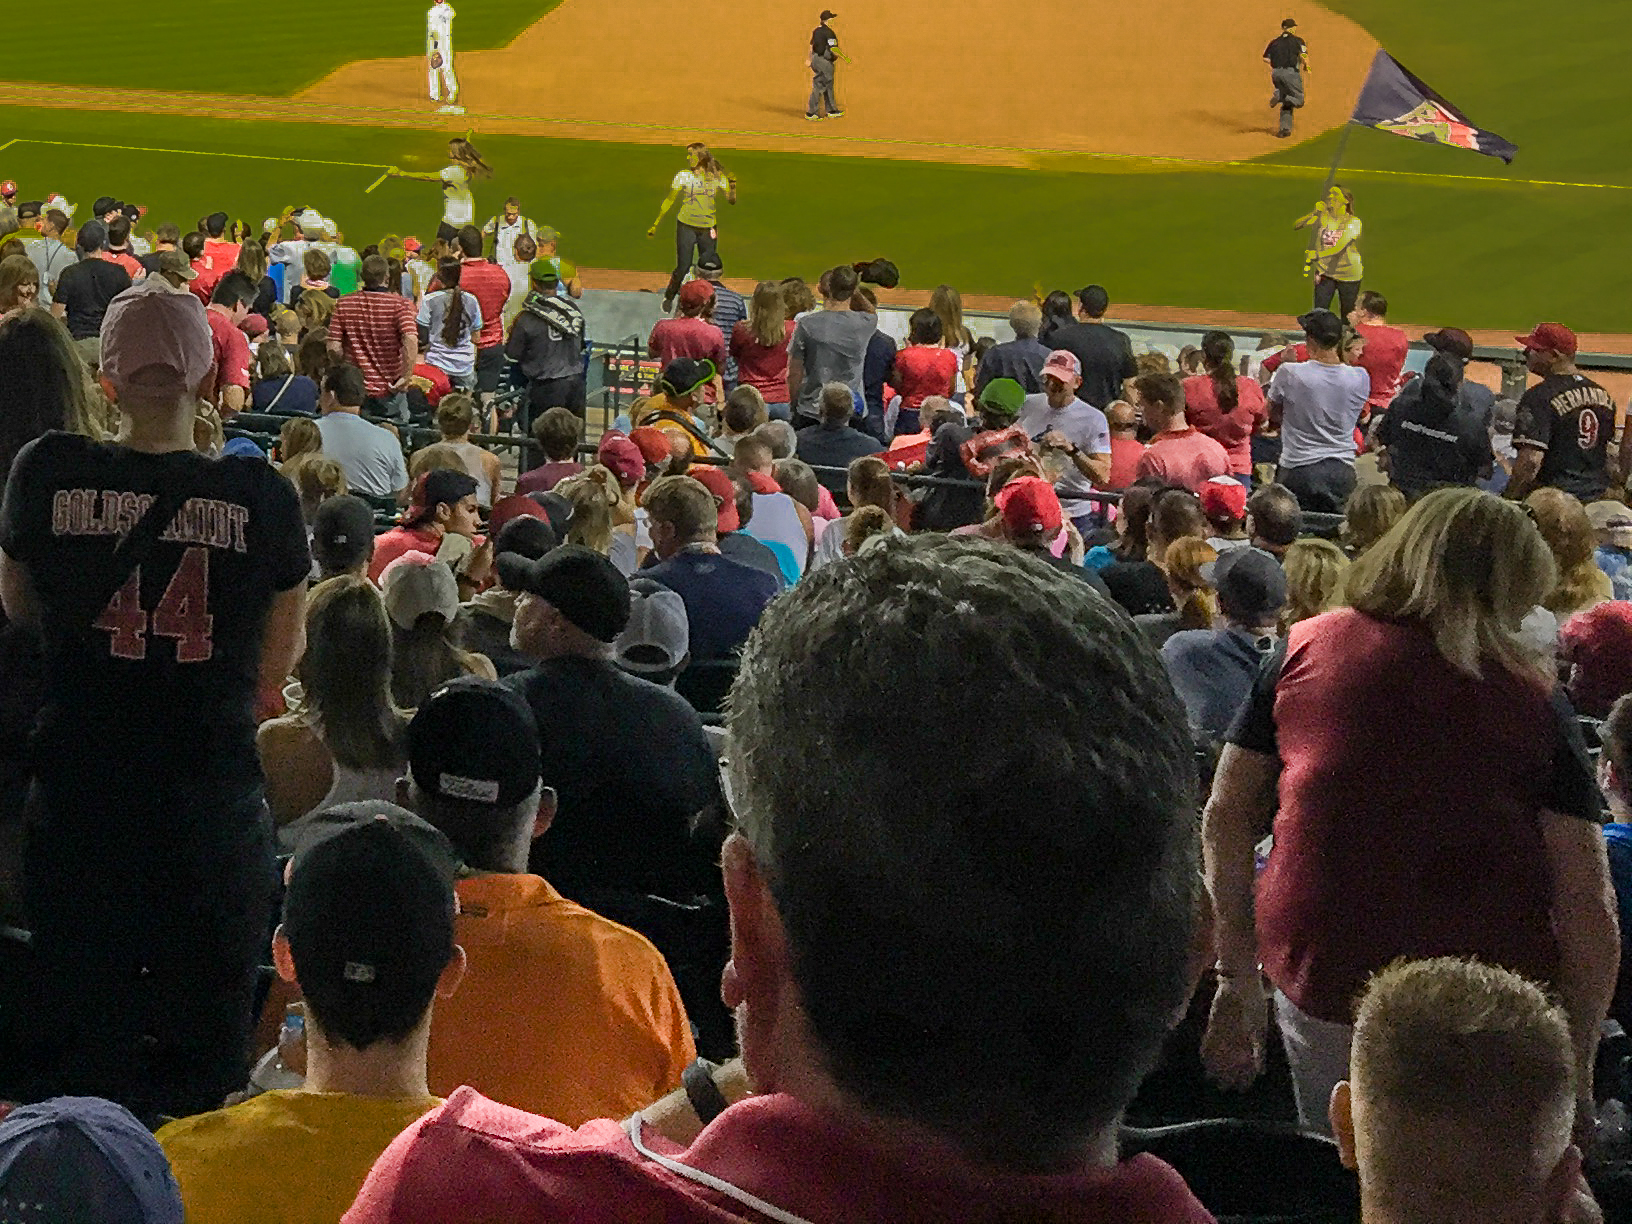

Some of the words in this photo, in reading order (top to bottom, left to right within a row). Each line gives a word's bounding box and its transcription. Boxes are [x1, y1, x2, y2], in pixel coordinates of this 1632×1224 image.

[1577, 408, 1599, 450] 9
[52, 488, 249, 554] GOLDSMIDT
[91, 546, 214, 664] 44
